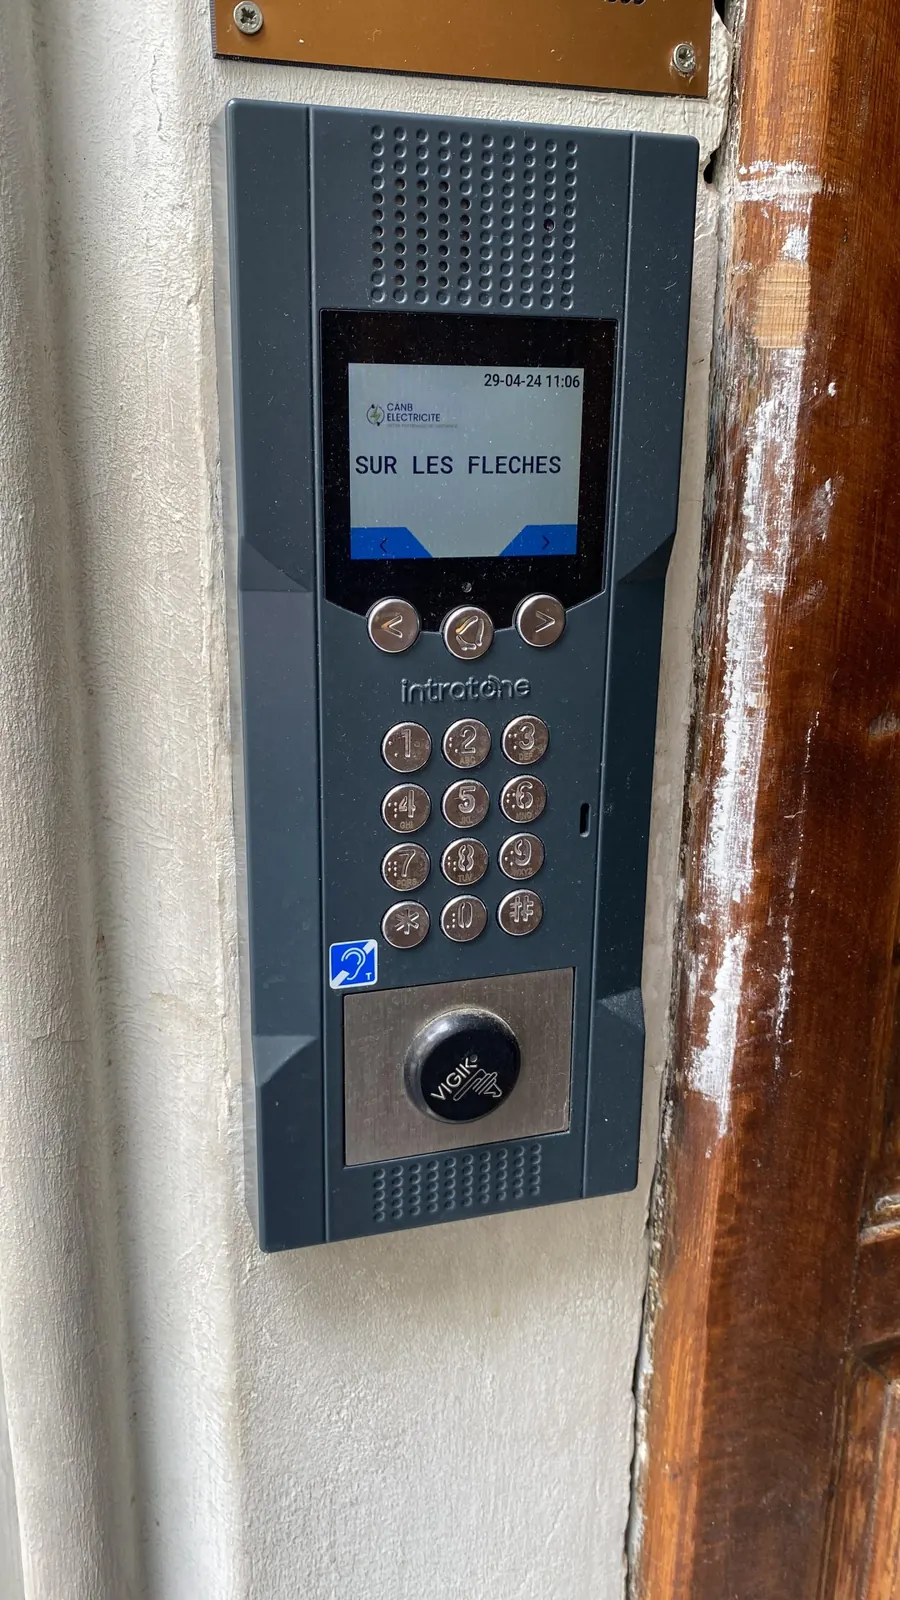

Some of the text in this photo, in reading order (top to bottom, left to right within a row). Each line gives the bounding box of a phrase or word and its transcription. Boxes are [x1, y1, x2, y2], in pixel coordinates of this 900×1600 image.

[484, 373, 580, 388] 29-04-24 11:06
[386, 402, 413, 412] CANB
[386, 413, 441, 422] ELECTRICITE
[355, 455, 562, 475] SUR LES FLECHES
[401, 674, 532, 703] intratone
[400, 728, 412, 758] 1
[460, 725, 477, 754] 2
[519, 722, 536, 751] 3
[399, 789, 416, 818] 4
[458, 785, 477, 814] 5
[516, 780, 534, 809] 6
[399, 849, 416, 878] 7
[458, 844, 475, 872] 8
[514, 838, 532, 867] 9
[458, 901, 473, 929] 0
[365, 972, 372, 981] T
[430, 1056, 478, 1101] VIGIK
